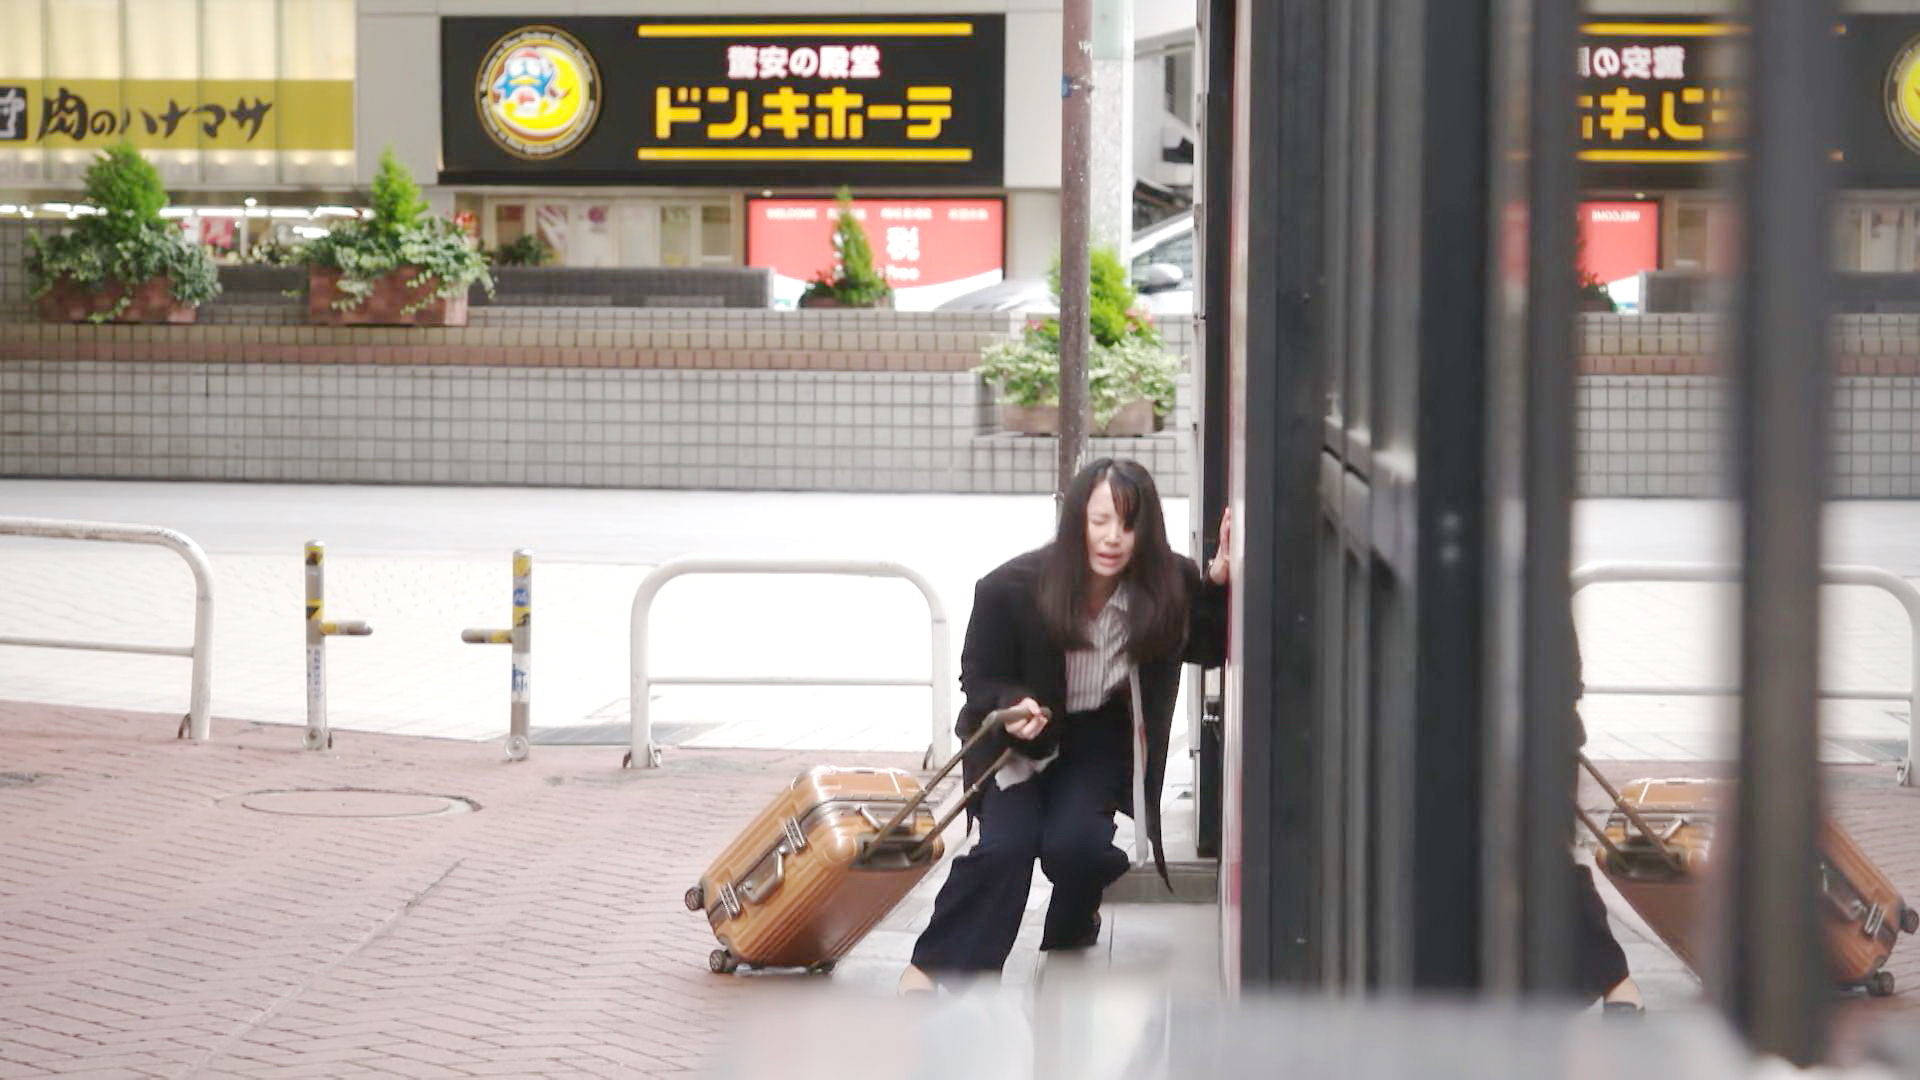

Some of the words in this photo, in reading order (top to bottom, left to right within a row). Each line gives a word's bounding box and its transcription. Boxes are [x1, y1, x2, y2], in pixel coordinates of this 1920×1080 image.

[727, 45, 881, 79] 驚安の殿堂
[37, 87, 272, 142] 肉のハナマサ
